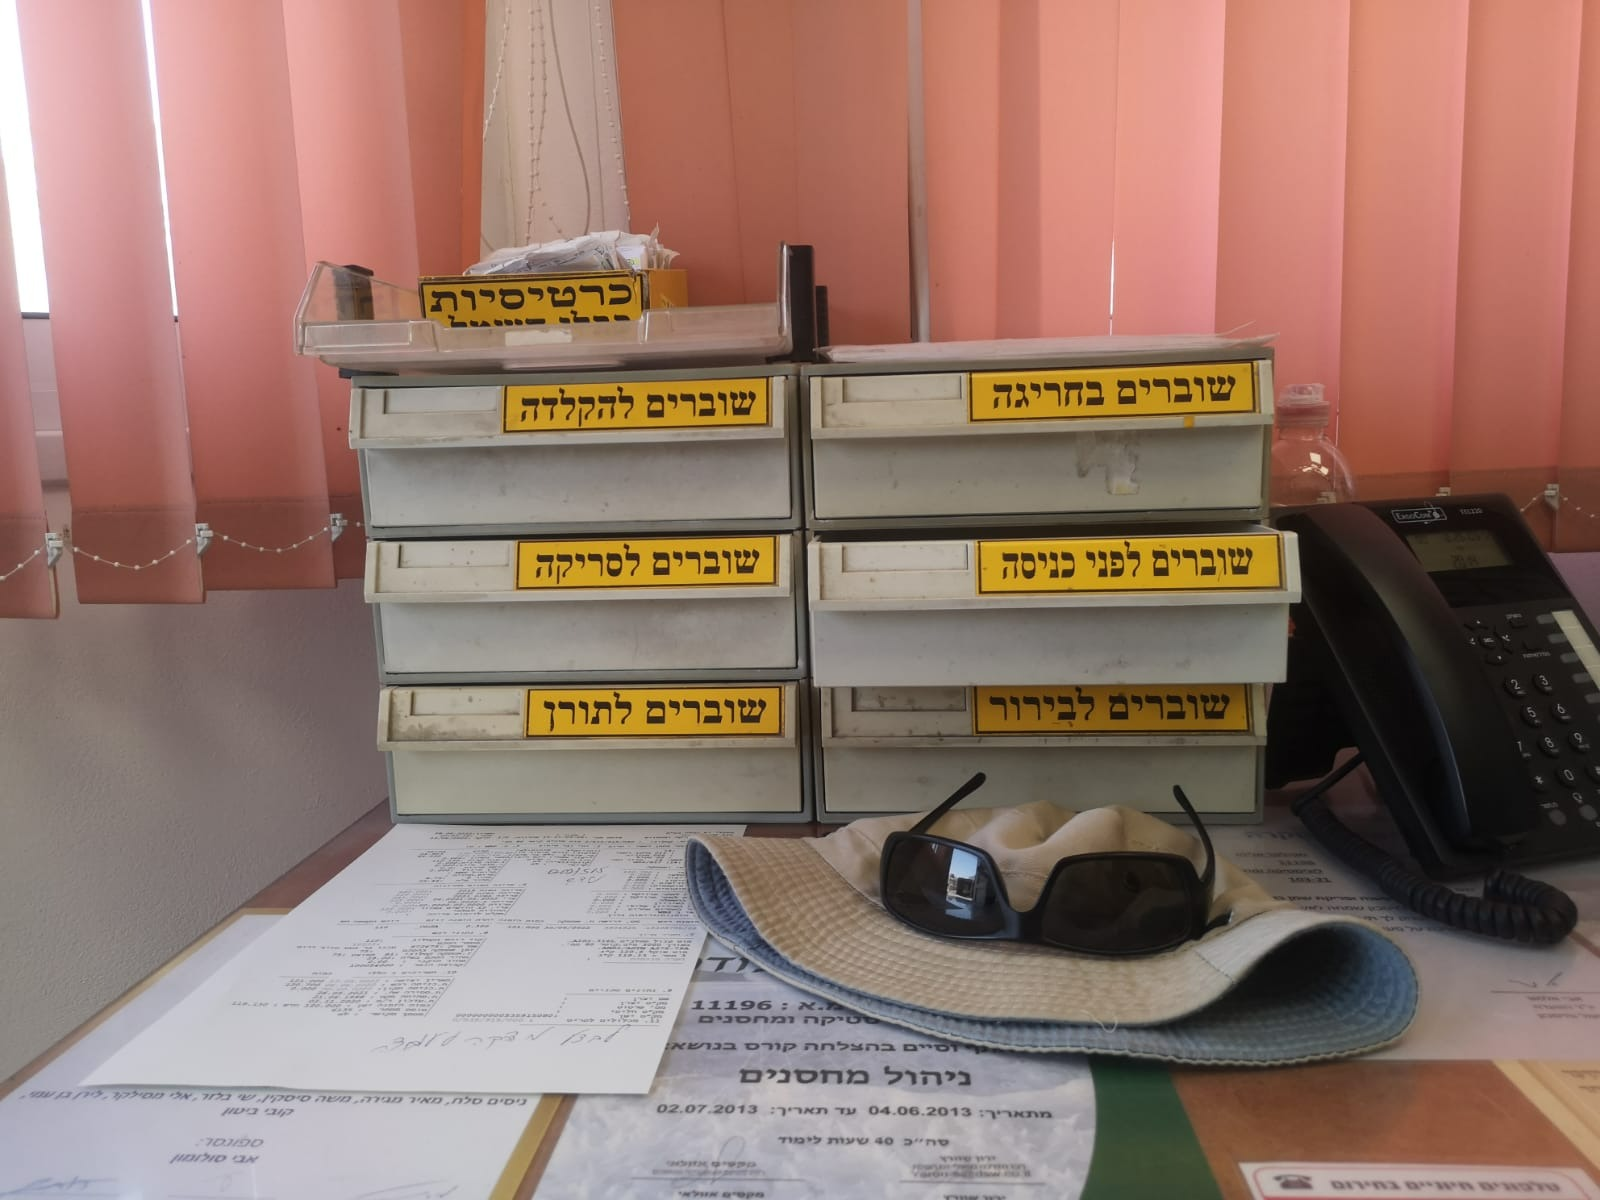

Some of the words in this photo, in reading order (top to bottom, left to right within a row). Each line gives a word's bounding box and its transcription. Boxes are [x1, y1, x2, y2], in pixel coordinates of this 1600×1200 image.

[430, 283, 633, 313] כרטיסיות
[993, 380, 1105, 410] בחריגה
[1116, 375, 1236, 405] שוברים
[520, 386, 635, 427] להקלדה
[646, 390, 757, 419] שוברים
[535, 544, 641, 585] לסריקה
[652, 549, 760, 577] שוברים
[1002, 550, 1076, 580] כניסה
[1085, 540, 1141, 579] לפני
[1152, 547, 1254, 579] שוברים
[988, 687, 1096, 721] לבירור
[1108, 692, 1230, 721] שוברים
[543, 692, 632, 732] לתורן
[645, 699, 767, 726] שוברים
[690, 999, 772, 1011] 11196
[697, 1014, 796, 1026] ומחסנים
[745, 1040, 796, 1055] קורס
[803, 1039, 897, 1053] בהצלחה
[903, 1041, 959, 1053] וסיים
[738, 1066, 870, 1085] מחסנים
[884, 1064, 972, 1087] ניהול
[314, 1094, 352, 1104] משה
[486, 1096, 527, 1107] ניסים
[264, 1106, 295, 1118] קובי
[656, 1103, 759, 1115] 02.07.2013
[770, 1104, 828, 1117] תאריך:
[834, 1106, 857, 1116] עד
[868, 1105, 973, 1117] 04.06.2013
[978, 1108, 1054, 1120] מתאריך:
[777, 1134, 822, 1146] לימוד
[827, 1135, 870, 1147] שעות
[873, 1136, 894, 1146] 40
[231, 1154, 260, 1164] אבי
[1478, 1178, 1561, 1193] טלפונים
